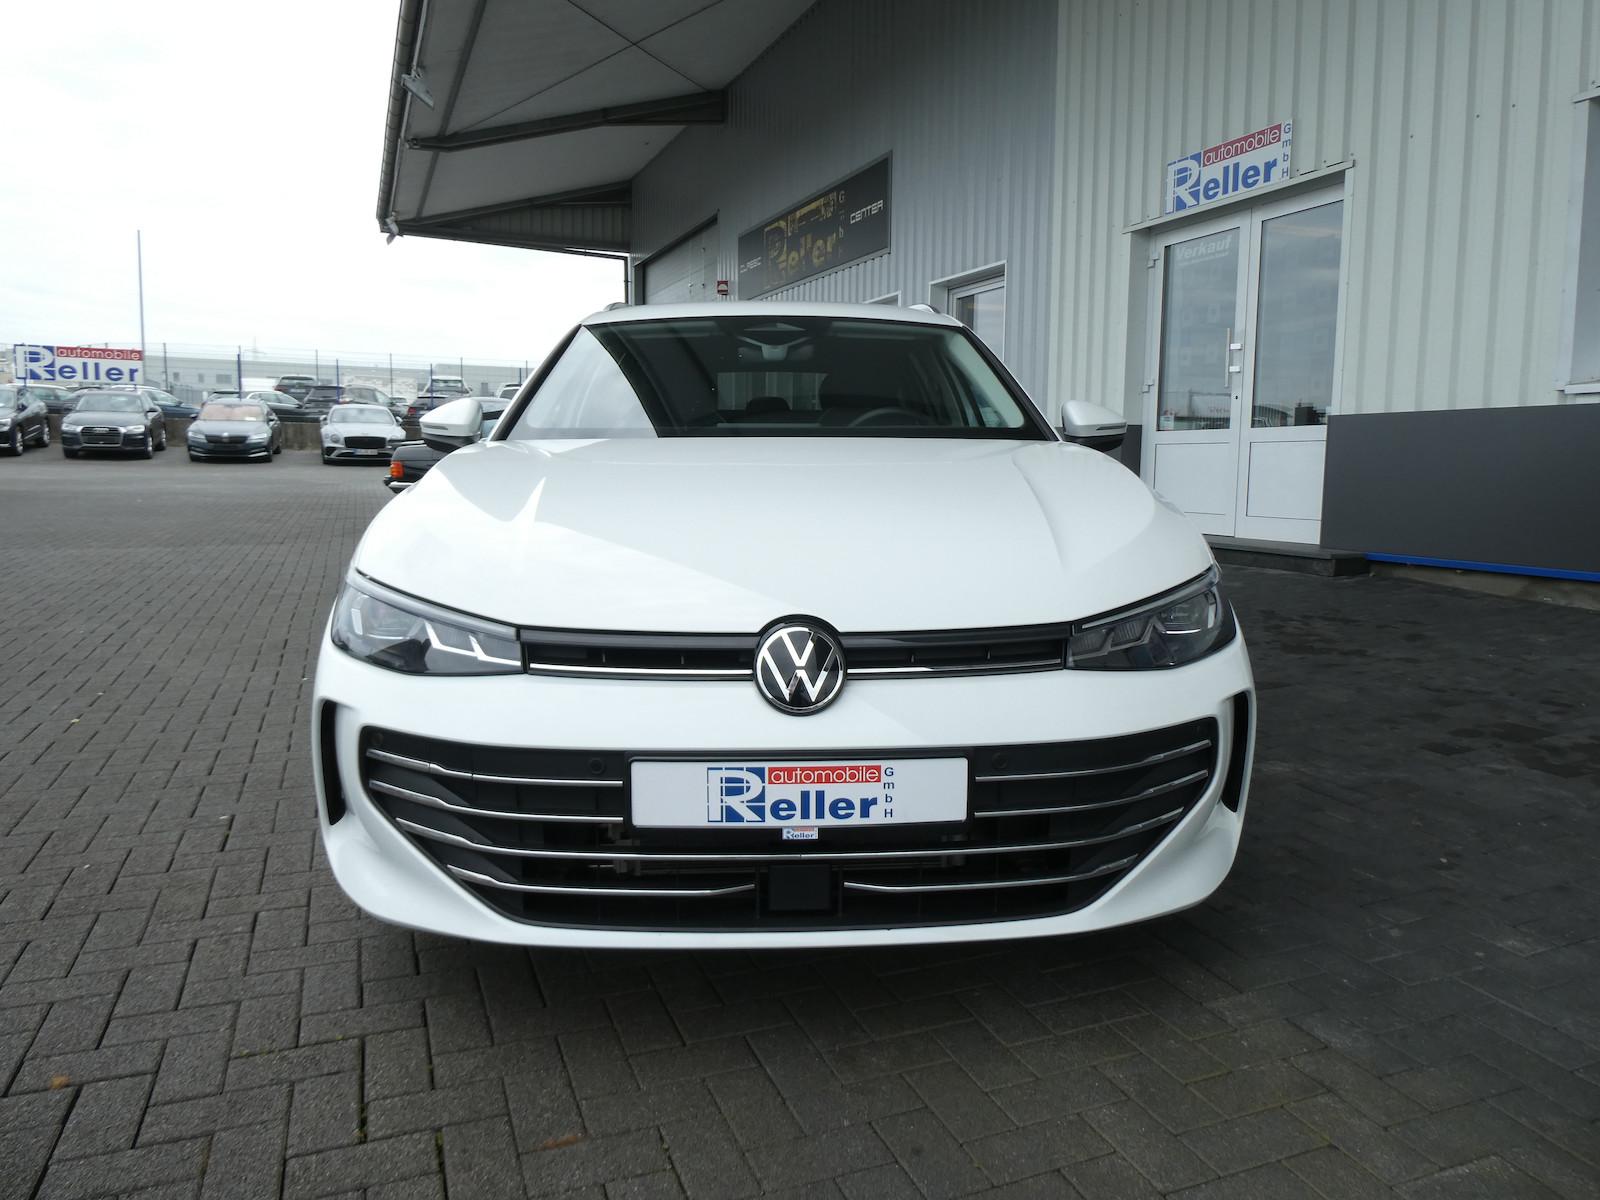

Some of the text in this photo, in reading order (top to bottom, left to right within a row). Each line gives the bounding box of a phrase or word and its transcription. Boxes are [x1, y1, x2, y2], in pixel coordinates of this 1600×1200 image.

[1204, 128, 1280, 166] automobile
[1164, 151, 1278, 215] Reller
[1175, 234, 1232, 261] Verkauf
[14, 344, 140, 382] Reller
[57, 347, 140, 361] automobile
[770, 766, 879, 784] automobile
[883, 767, 895, 819] GmbH
[706, 766, 878, 823] Reller
